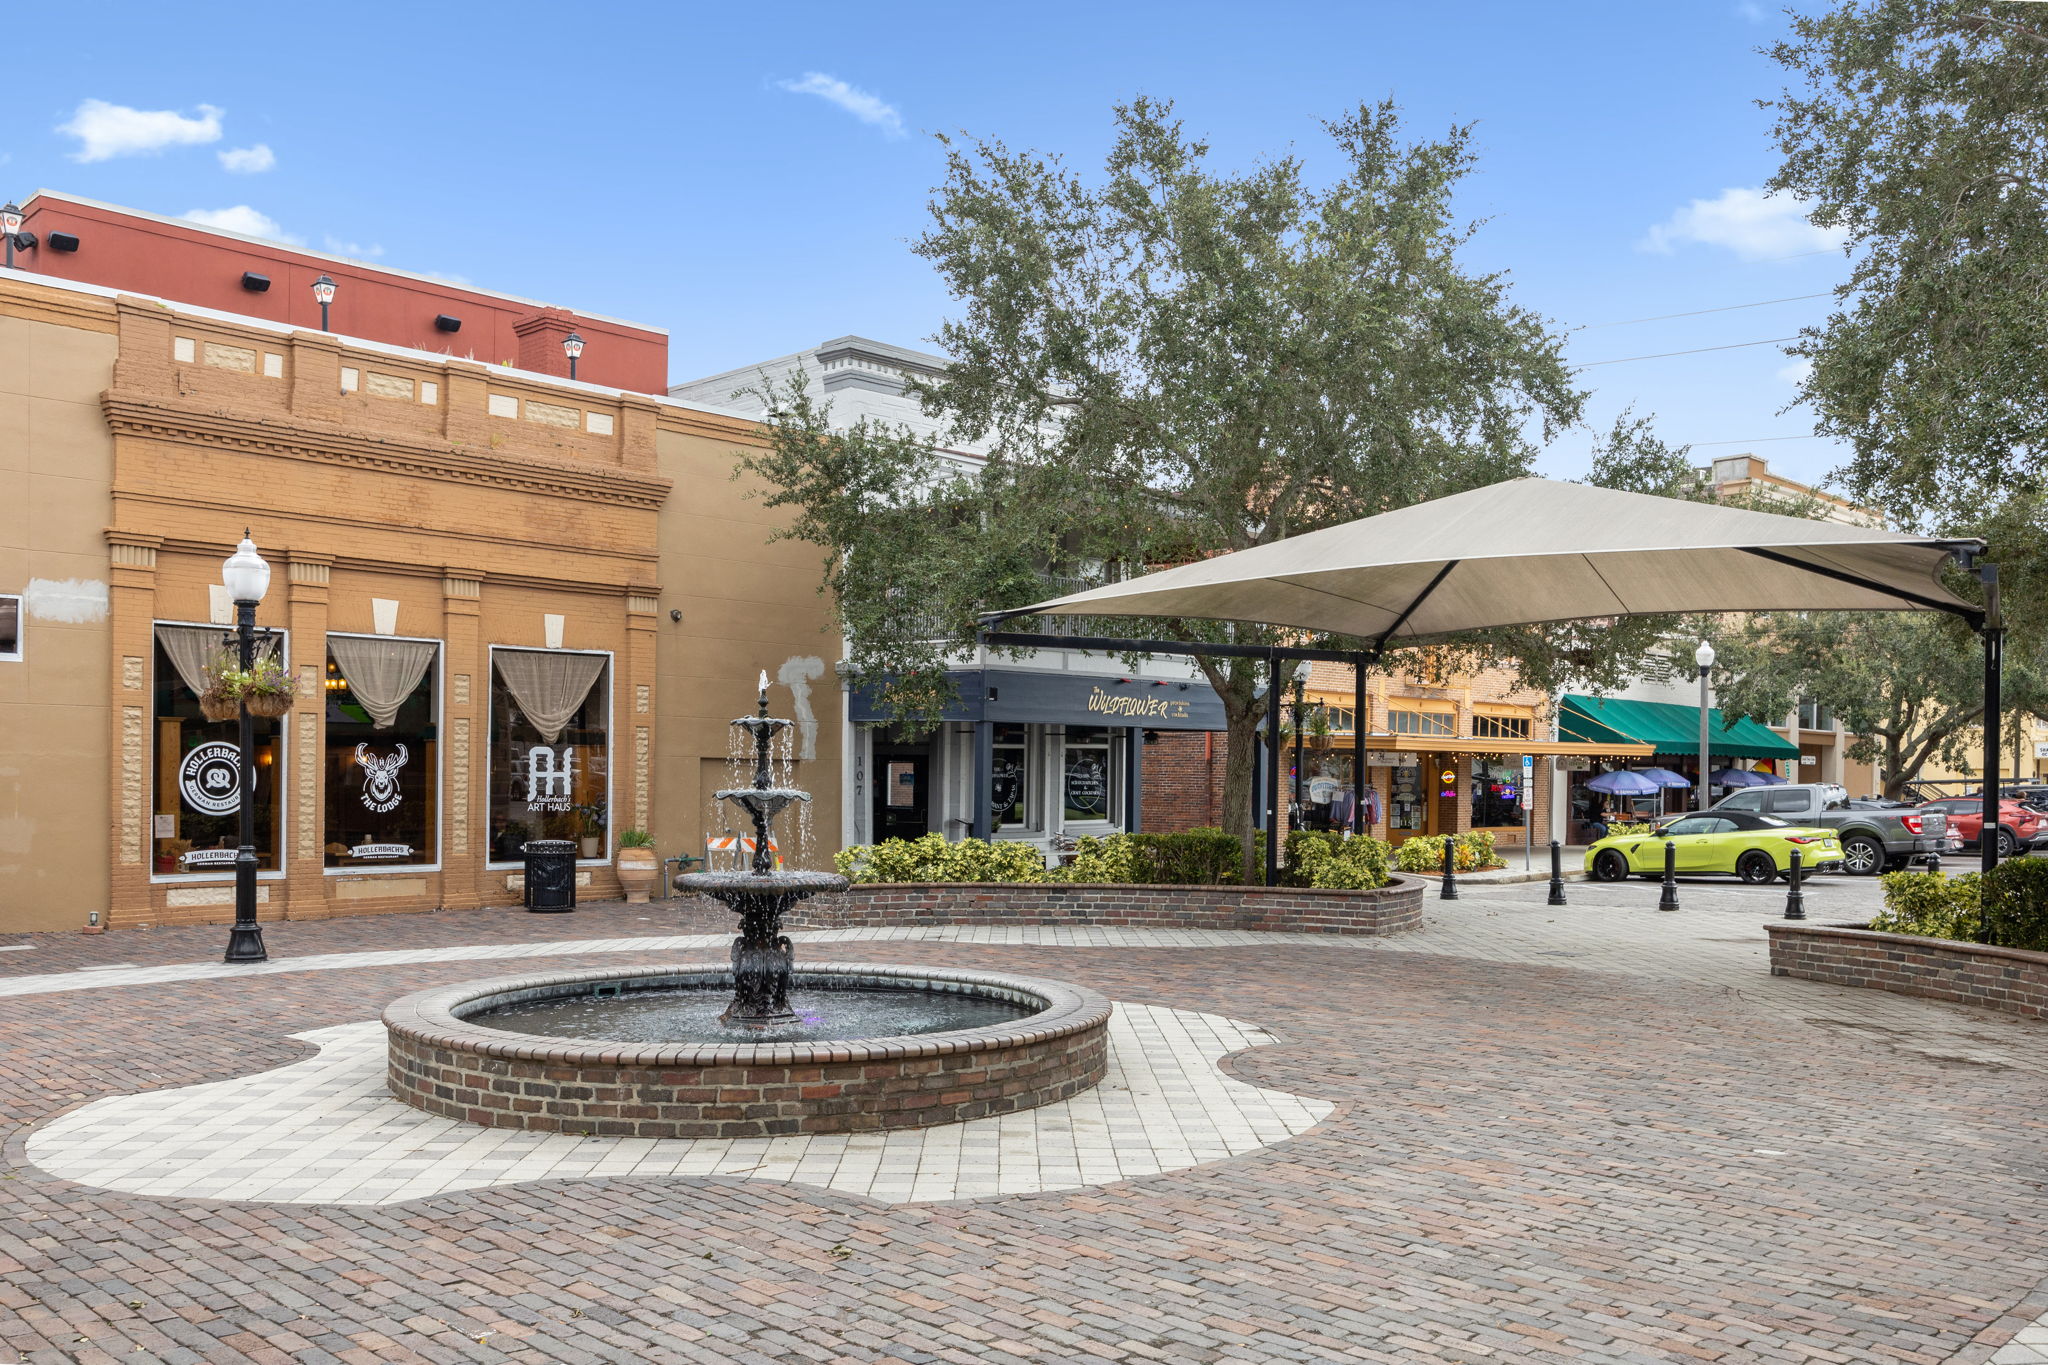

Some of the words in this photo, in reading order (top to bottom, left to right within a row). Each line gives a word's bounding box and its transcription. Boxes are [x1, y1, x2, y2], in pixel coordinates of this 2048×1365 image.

[1088, 690, 1168, 719] WILDFLOWER
[185, 747, 240, 776] HOLLERBAC
[856, 756, 864, 796] 107
[190, 785, 210, 806] GERMAN
[212, 795, 240, 807] RESTAUR
[361, 793, 377, 811] THE
[377, 793, 402, 813] LODGE
[527, 803, 545, 811] ART
[547, 803, 571, 811] HAUS
